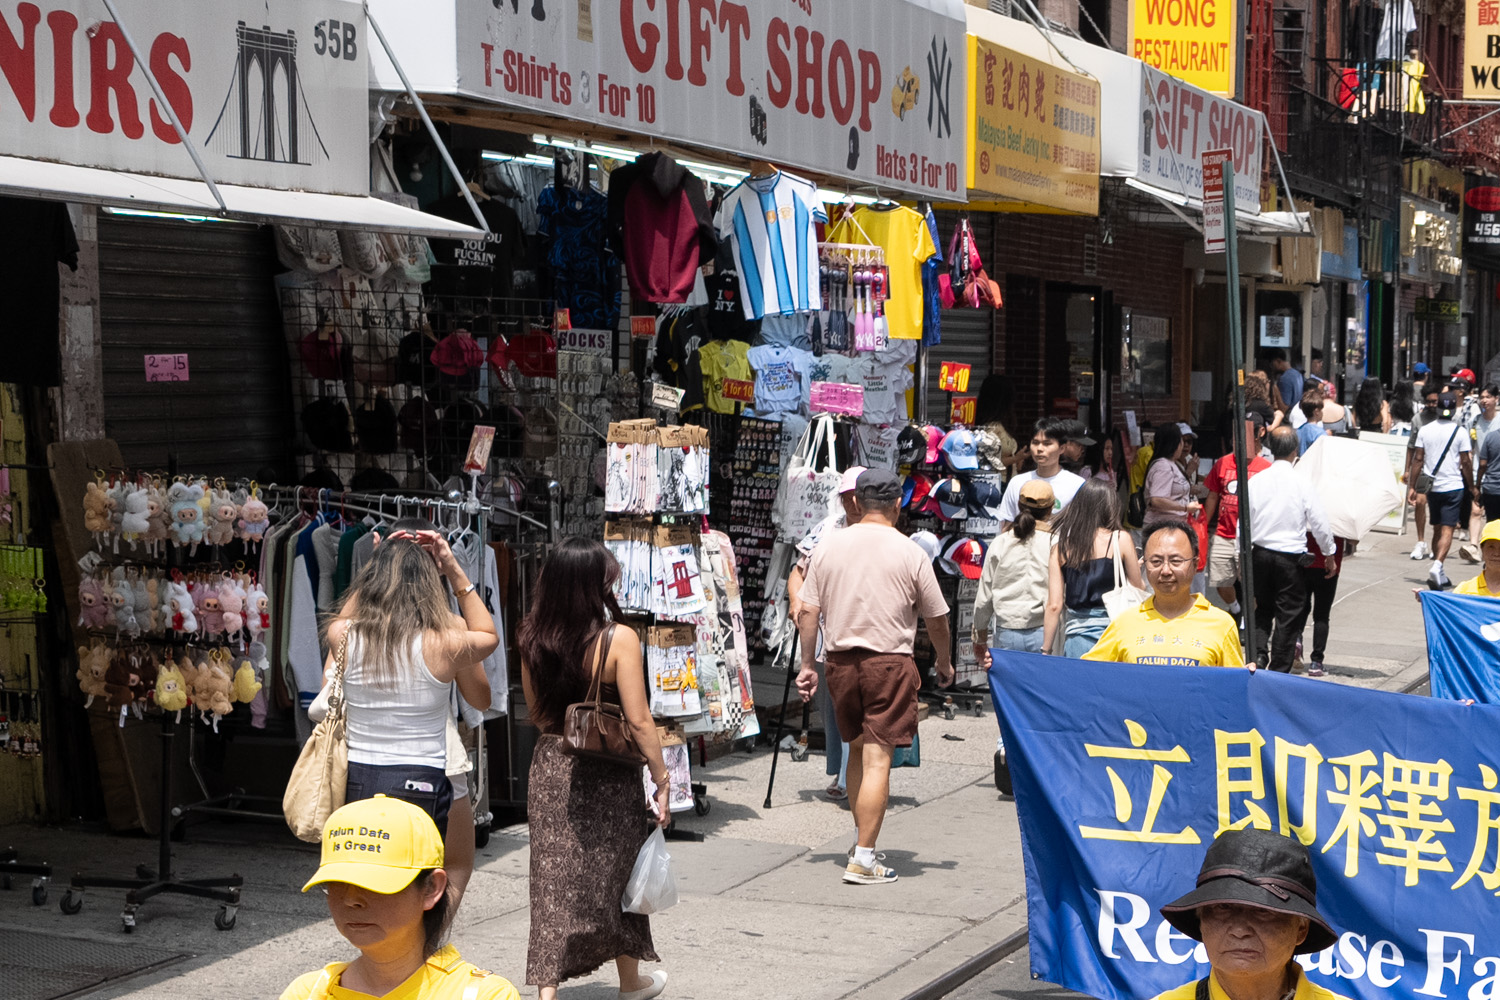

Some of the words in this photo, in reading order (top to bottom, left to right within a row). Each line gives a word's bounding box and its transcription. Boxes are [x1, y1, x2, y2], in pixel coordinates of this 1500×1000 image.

[1146, 0, 1216, 28] WONG
[314, 19, 358, 61] 55B
[1134, 39, 1228, 72] RESTAURANT
[620, 0, 750, 96] GIFT
[767, 17, 882, 132] SHOP
[481, 42, 572, 105] T-Shirts
[598, 73, 631, 118] For
[636, 83, 656, 124] 10
[1155, 79, 1204, 159] GIFT
[978, 116, 1006, 152] Malaysia
[1008, 125, 1022, 152] Beef
[1023, 133, 1039, 163] Jerky
[876, 144, 907, 182] Hats
[910, 152, 918, 184] 3
[921, 156, 942, 190] For
[945, 162, 957, 192] 10
[1157, 157, 1169, 178] ALL
[1170, 161, 1184, 182] KIND
[1187, 165, 1195, 185] OF
[1481, 213, 1495, 222] NEW
[462, 240, 486, 252] YOU
[454, 248, 496, 263] FUCKIN'
[718, 290, 724, 300] I
[714, 300, 735, 312] NY
[559, 331, 606, 349] SOCKS
[148, 356, 159, 368] 2
[173, 355, 186, 370] 15
[940, 365, 948, 389] 3
[953, 367, 970, 392] $10
[723, 384, 729, 393] 4
[730, 384, 742, 395] for
[744, 385, 753, 396] 10
[870, 446, 886, 456] Little
[806, 482, 835, 492] NEW
[806, 493, 830, 509] YORK
[948, 492, 964, 502] NY
[1138, 657, 1168, 666] FALUN
[1171, 658, 1196, 667] DAFA
[328, 827, 354, 839] Falun
[359, 826, 390, 841] Dafa
[345, 840, 382, 853] Great
